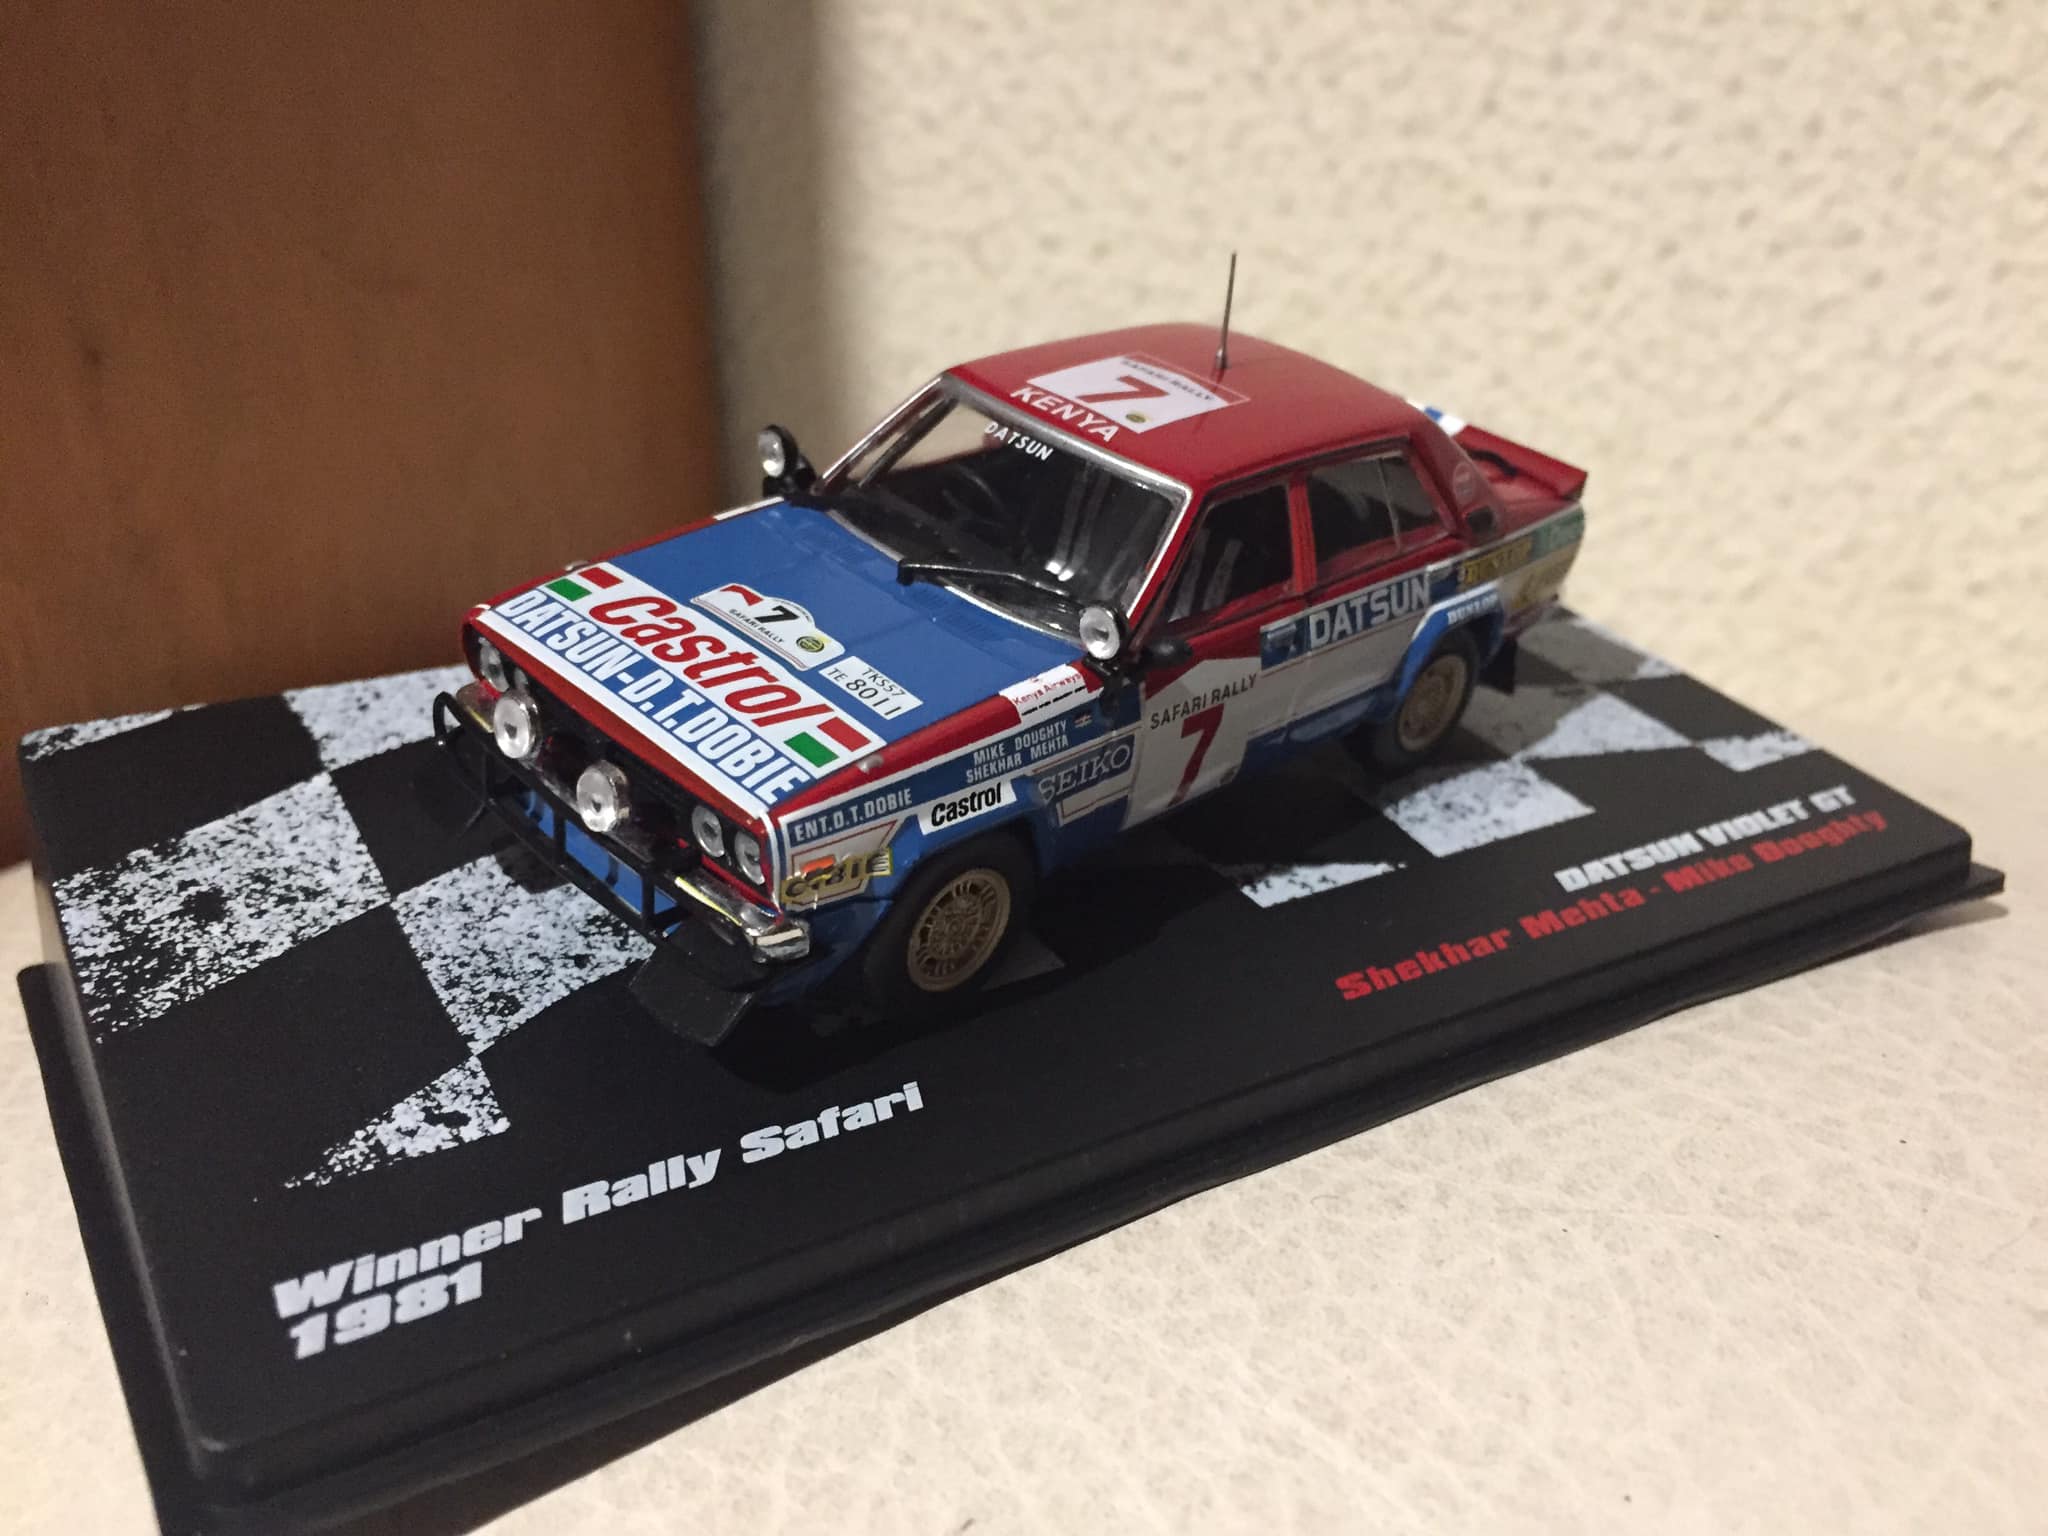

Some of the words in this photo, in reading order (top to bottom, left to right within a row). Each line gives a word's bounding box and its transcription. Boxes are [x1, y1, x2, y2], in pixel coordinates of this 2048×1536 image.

[1010, 386, 1121, 443] KENYA
[1075, 374, 1170, 404] 7
[983, 421, 1054, 462] DATSUN
[756, 605, 800, 624] 7
[757, 624, 785, 644] RALLY
[1308, 571, 1430, 649] DATSUN
[588, 596, 835, 729] Castrol
[501, 590, 811, 804] DATSUN-D.T.DOBIE
[826, 668, 848, 682] TE
[846, 678, 903, 717] 8011
[1150, 693, 1207, 730] SAFARI
[1210, 673, 1258, 705] RALLY
[965, 754, 1023, 784] SHEKHAR
[1030, 735, 1069, 760] MEHTA
[973, 743, 1006, 766] MIKE
[1014, 719, 1068, 751] DOUGHTY
[1167, 702, 1225, 808] 7
[1036, 744, 1131, 802] SEIKO
[930, 783, 1003, 827] Castrol
[1554, 829, 1702, 893] DATSUN
[1697, 799, 1810, 848] VIOLET
[1811, 784, 1858, 813] GT
[1334, 927, 1512, 1001] Shekhar
[1518, 886, 1647, 940] Mehta
[1662, 848, 1755, 894] Mike
[1750, 808, 1888, 864] Doughty
[272, 1206, 544, 1320] Winner
[561, 1148, 722, 1225] Rally
[740, 1081, 924, 1164] Safari
[288, 1261, 484, 1361] 1981
